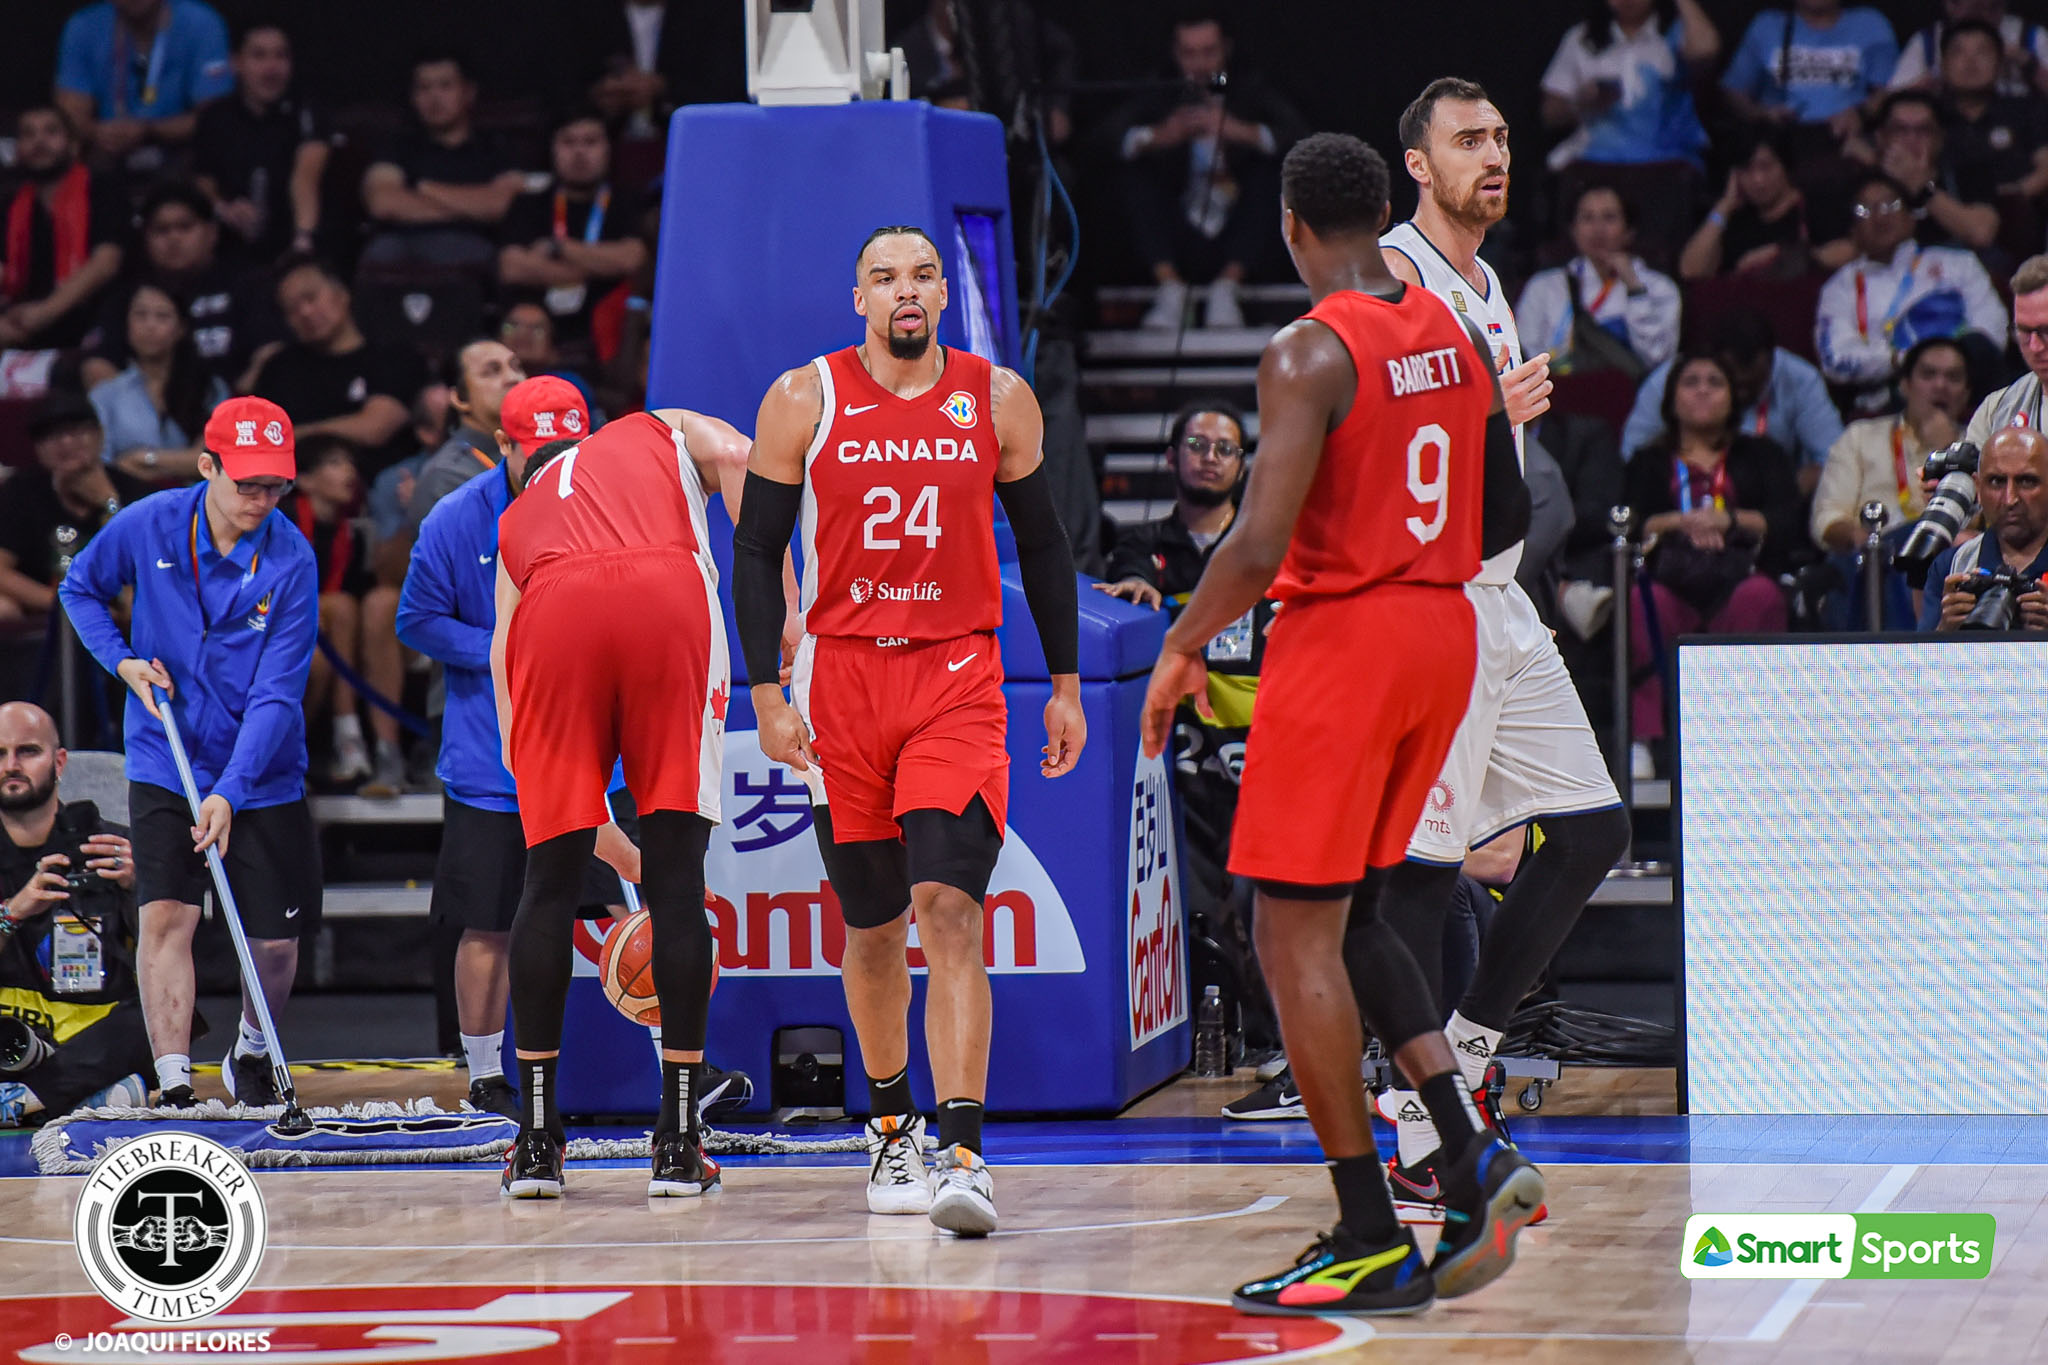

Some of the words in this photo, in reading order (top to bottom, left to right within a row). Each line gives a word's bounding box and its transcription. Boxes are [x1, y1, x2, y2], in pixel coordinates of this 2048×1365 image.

[1387, 347, 1461, 397] BARRETT
[533, 446, 580, 500] 7
[838, 438, 978, 464] CANADA
[1406, 423, 1450, 545] 9
[863, 485, 942, 550] 24
[876, 636, 909, 647] CAN
[1425, 819, 1451, 835] mts
